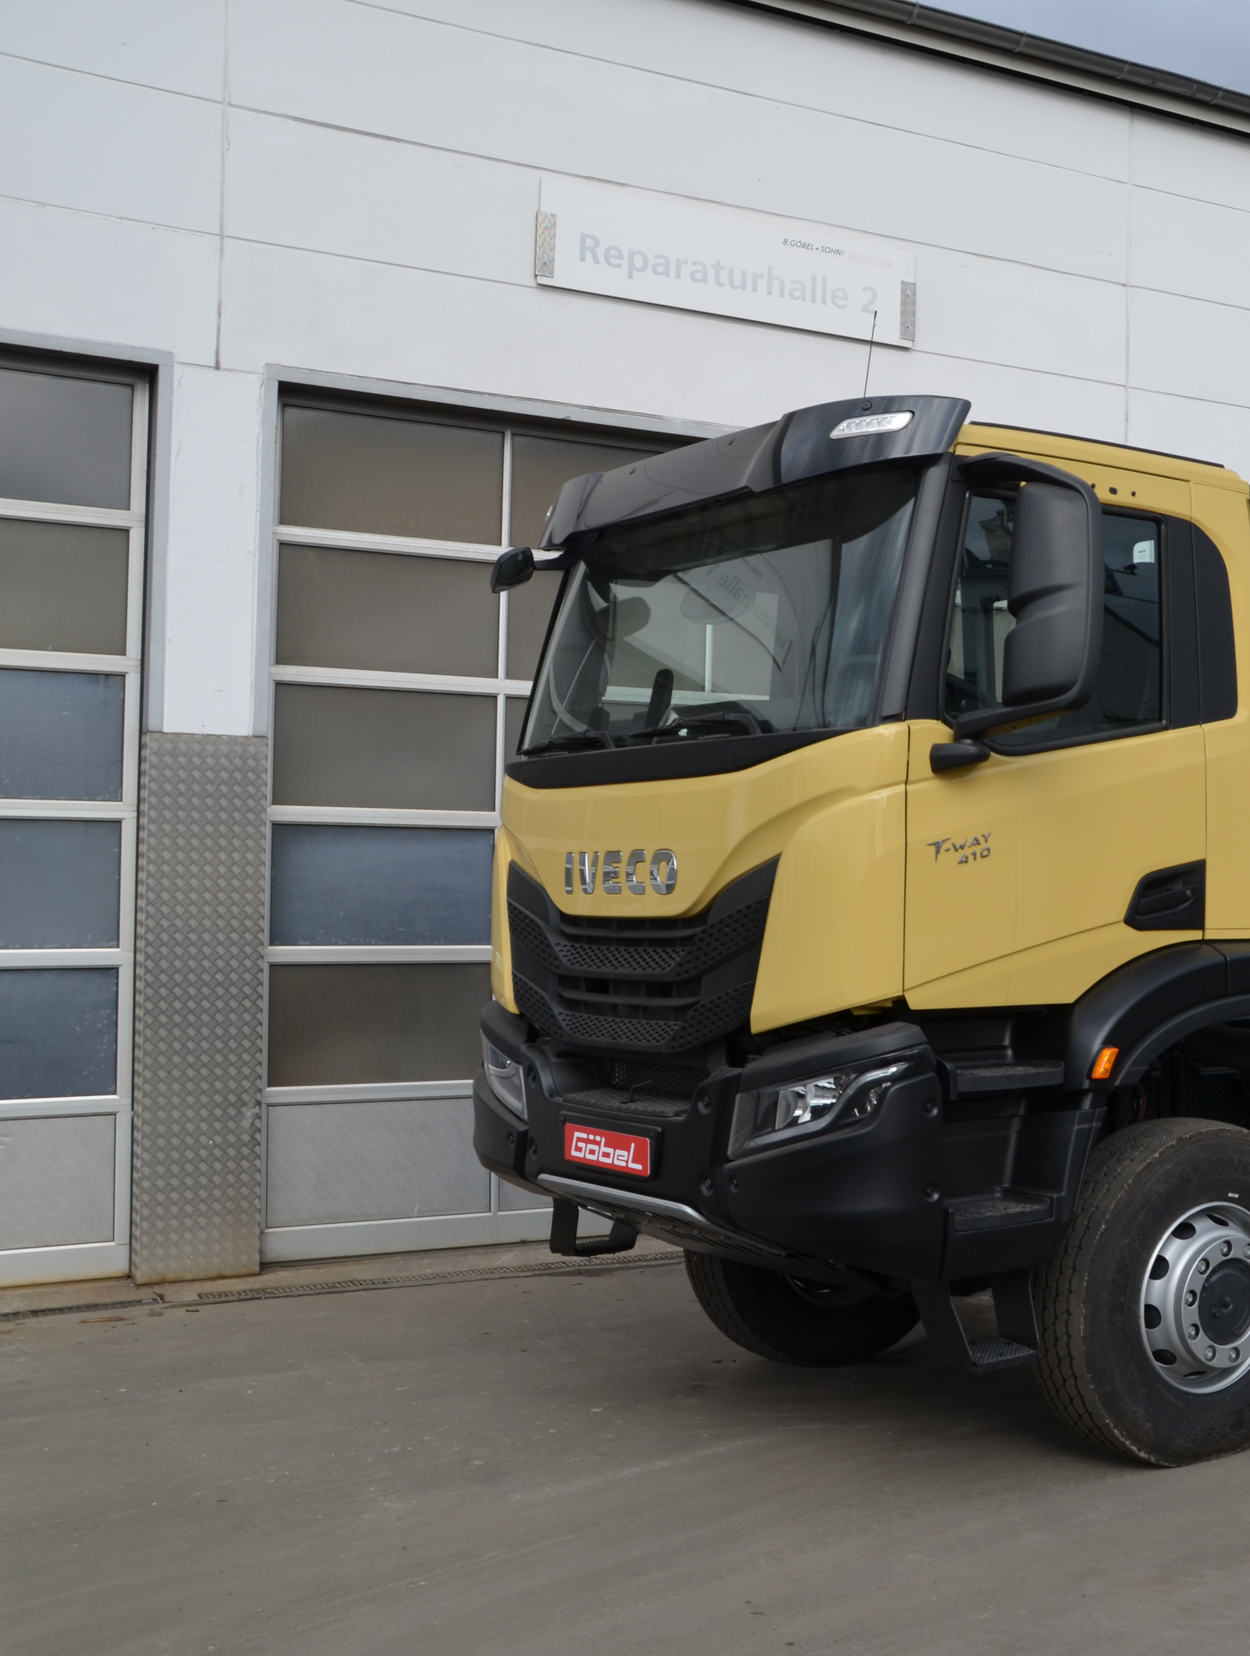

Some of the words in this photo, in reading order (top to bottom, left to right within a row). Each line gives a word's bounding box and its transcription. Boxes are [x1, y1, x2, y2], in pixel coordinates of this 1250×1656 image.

[578, 232, 849, 309] Reparaturhalle
[860, 285, 878, 314] 2
[926, 831, 992, 863] T-WAY
[957, 846, 991, 865] 410
[564, 848, 678, 895] IVECO
